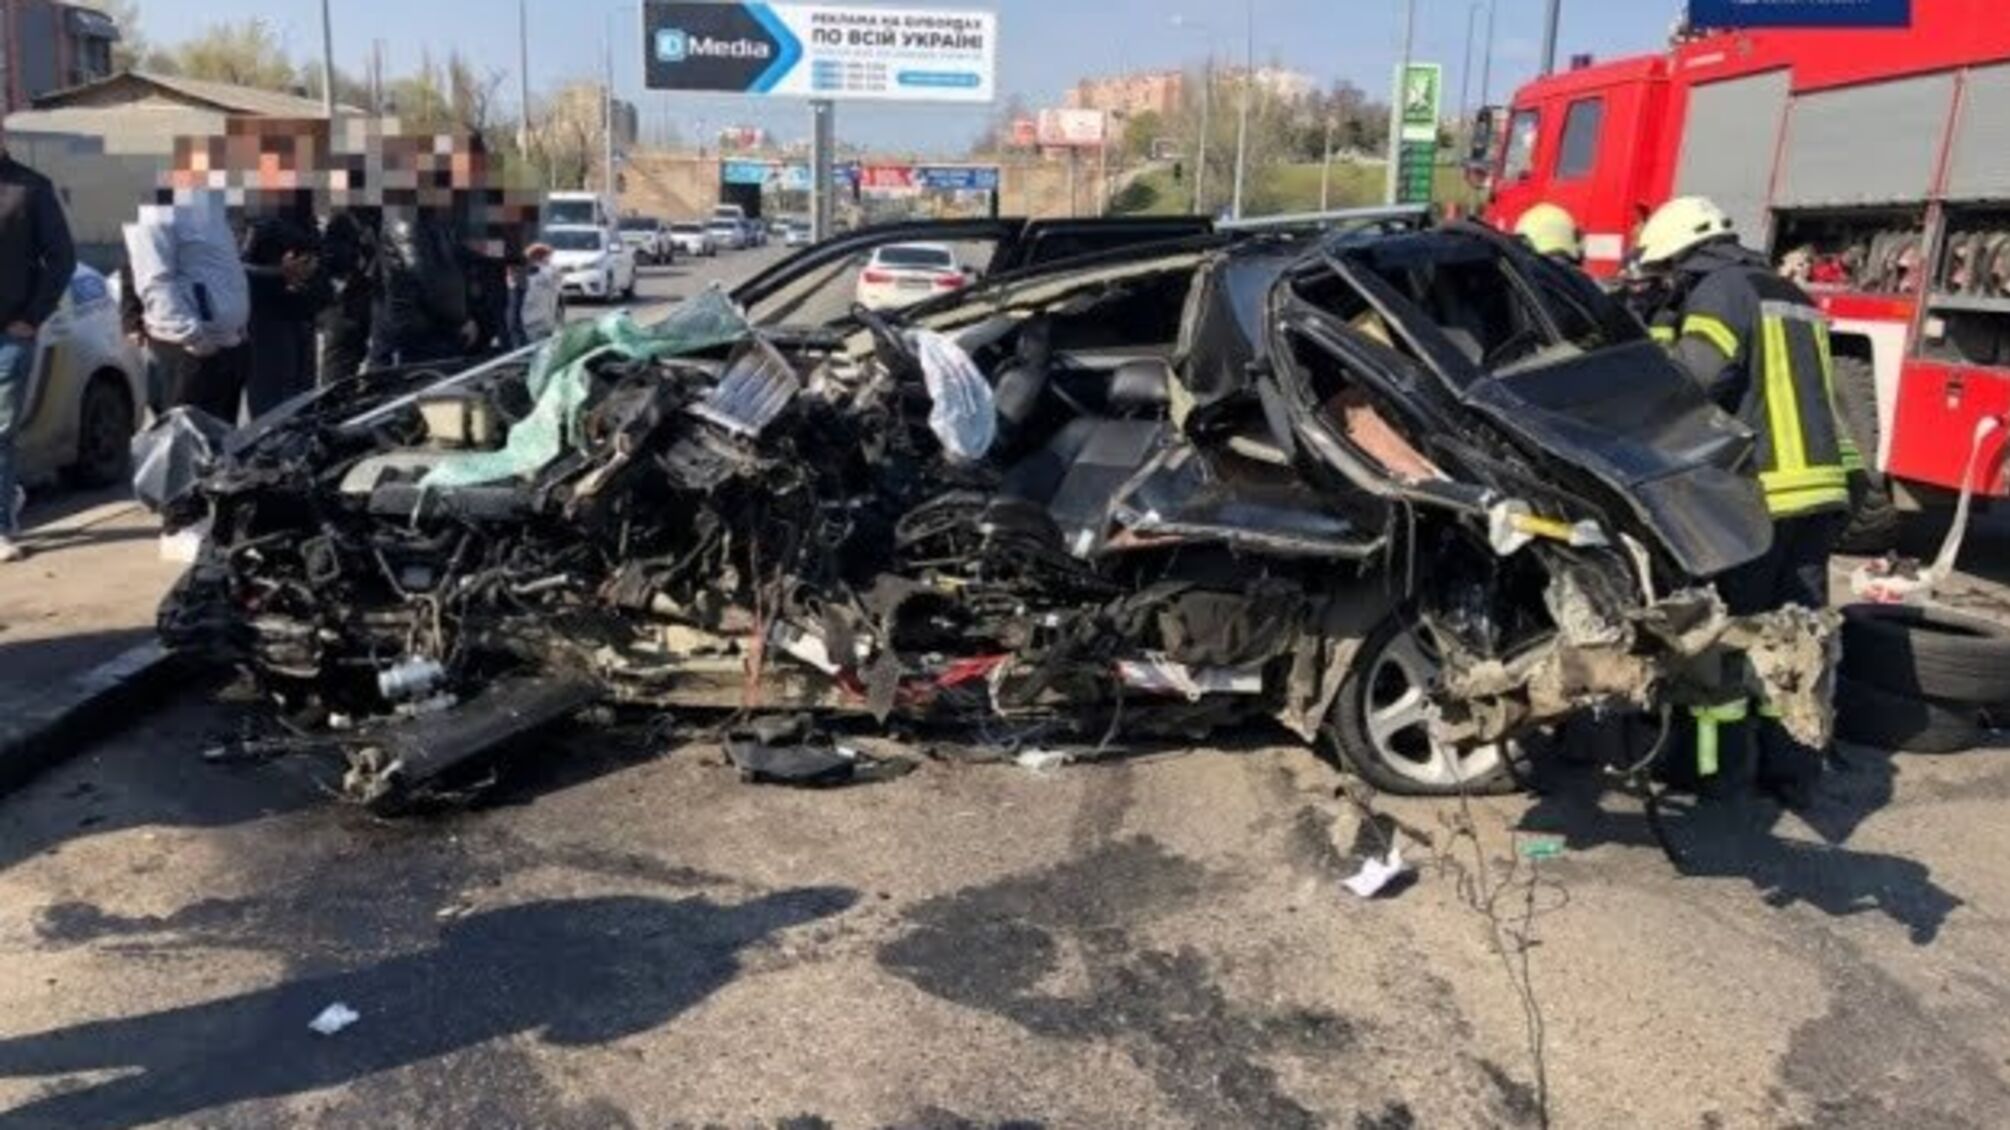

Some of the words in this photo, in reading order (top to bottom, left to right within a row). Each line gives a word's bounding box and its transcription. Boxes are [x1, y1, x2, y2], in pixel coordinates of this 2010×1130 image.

[811, 12, 877, 26] РЕКЛАМА
[882, 16, 900, 27] НА
[688, 36, 769, 59] Media
[811, 28, 842, 45] ПО
[848, 27, 896, 46] ВСІЙ
[902, 31, 983, 49] УКРАЇНІ
